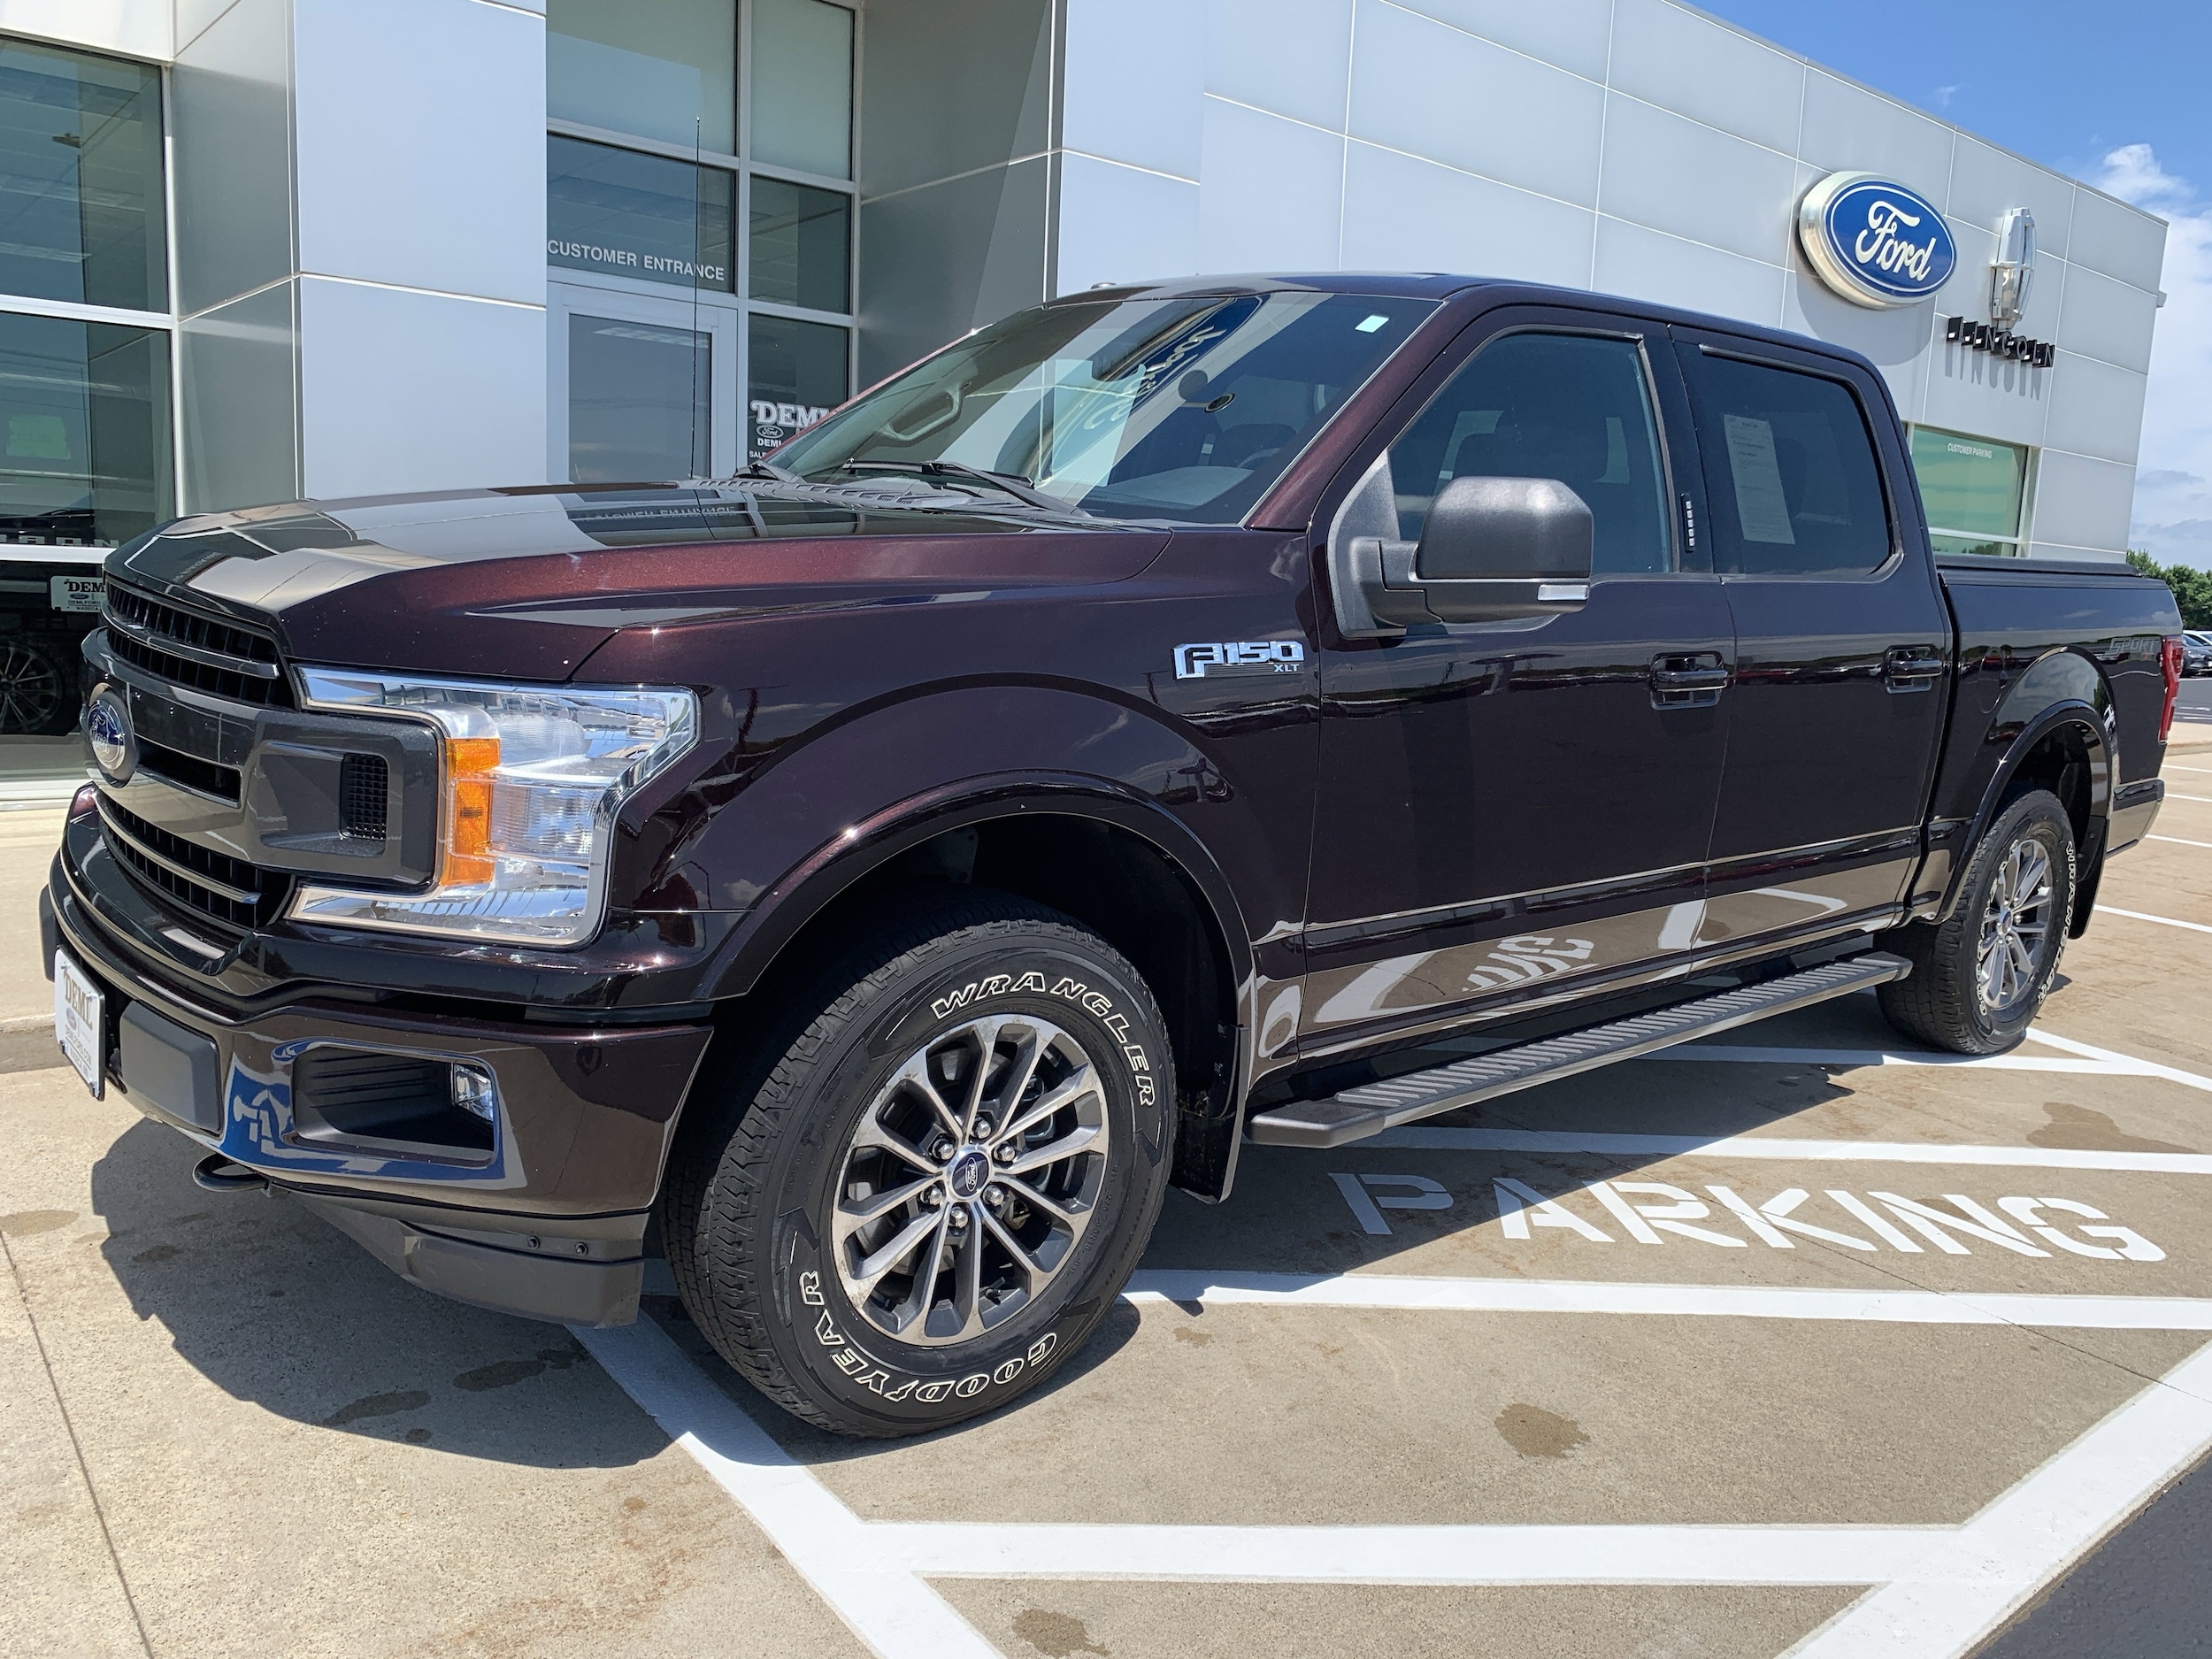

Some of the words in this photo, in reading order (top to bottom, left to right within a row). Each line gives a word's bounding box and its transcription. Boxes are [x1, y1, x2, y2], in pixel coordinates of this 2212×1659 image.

[547, 239, 637, 266] CUSTOMER
[643, 254, 725, 281] ENTRANCE
[1855, 200, 1938, 282] Ford
[1947, 442, 1973, 455] CUSTOMER
[1972, 448, 1993, 459] PARKING
[64, 579, 105, 593] DEM
[1273, 664, 1300, 673] XLT
[2105, 636, 2161, 657] SPORT
[2037, 840, 2076, 1005] WRANGLER
[63, 969, 93, 1032] DEML
[930, 972, 1156, 1106] WRANGLER
[1329, 1172, 2166, 1262] PARKING
[799, 1271, 1057, 1402] GOODYEAR
